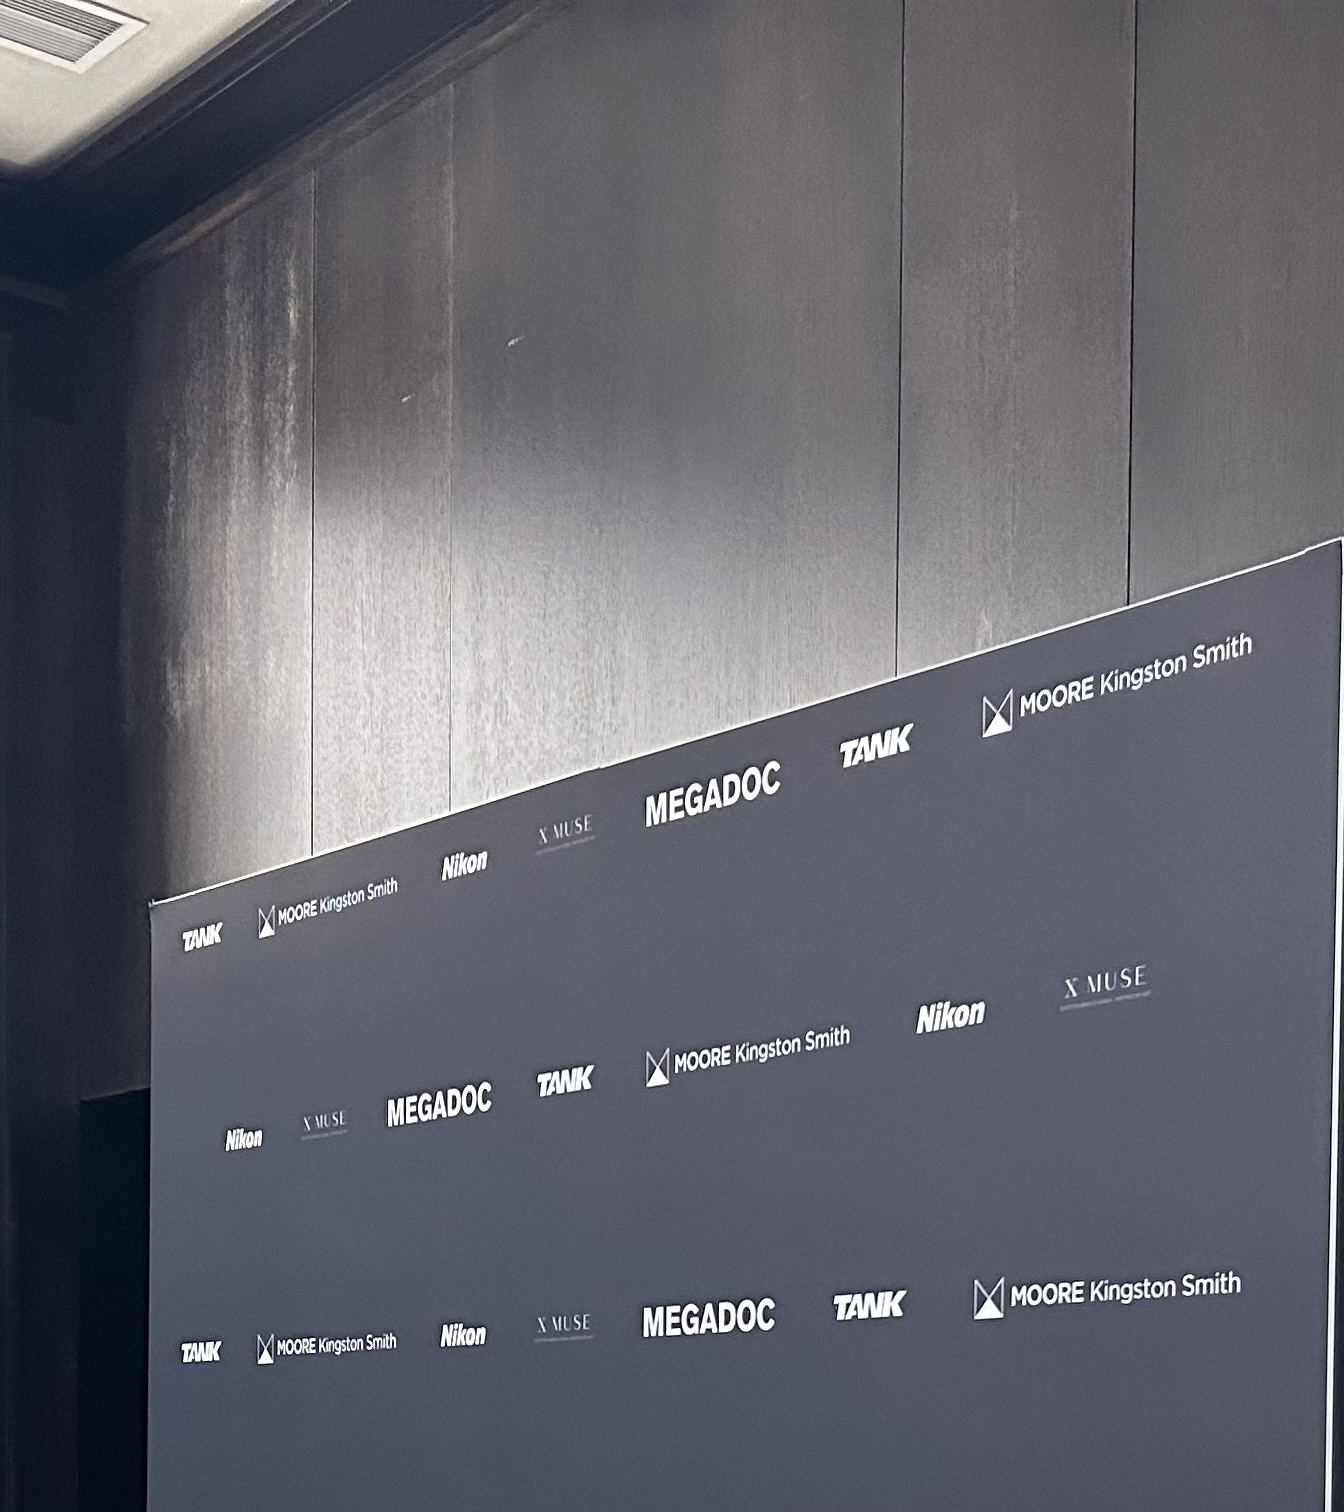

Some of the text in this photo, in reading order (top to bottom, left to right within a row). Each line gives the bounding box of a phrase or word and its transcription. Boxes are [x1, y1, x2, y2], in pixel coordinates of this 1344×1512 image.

[1020, 633, 1252, 717] MOORE Kingston Smith
[840, 723, 913, 768] TANK
[646, 761, 780, 827] MEGADOC
[553, 815, 593, 842] MUSE
[442, 851, 487, 881] Nikon
[279, 877, 397, 926] MOORE Kingston Smith
[183, 922, 223, 951] TANK
[1087, 964, 1148, 993] MUSE
[916, 1001, 985, 1034] Nikon
[675, 1025, 850, 1073] MOORE Kingston Smith
[537, 1065, 594, 1097] TANK
[388, 1082, 492, 1127] MEGADOC
[315, 1111, 347, 1129] MUSE
[226, 1128, 262, 1151] Nikon
[1011, 1271, 1241, 1306] MOORE Kingston Smith
[643, 1298, 775, 1337] MEGADOC
[834, 1290, 907, 1320] TANK
[441, 1323, 486, 1347] Nikon
[552, 1313, 592, 1332] MUSE
[182, 1341, 221, 1362] TANK
[277, 1333, 396, 1355] MOORE Kingston Smith
